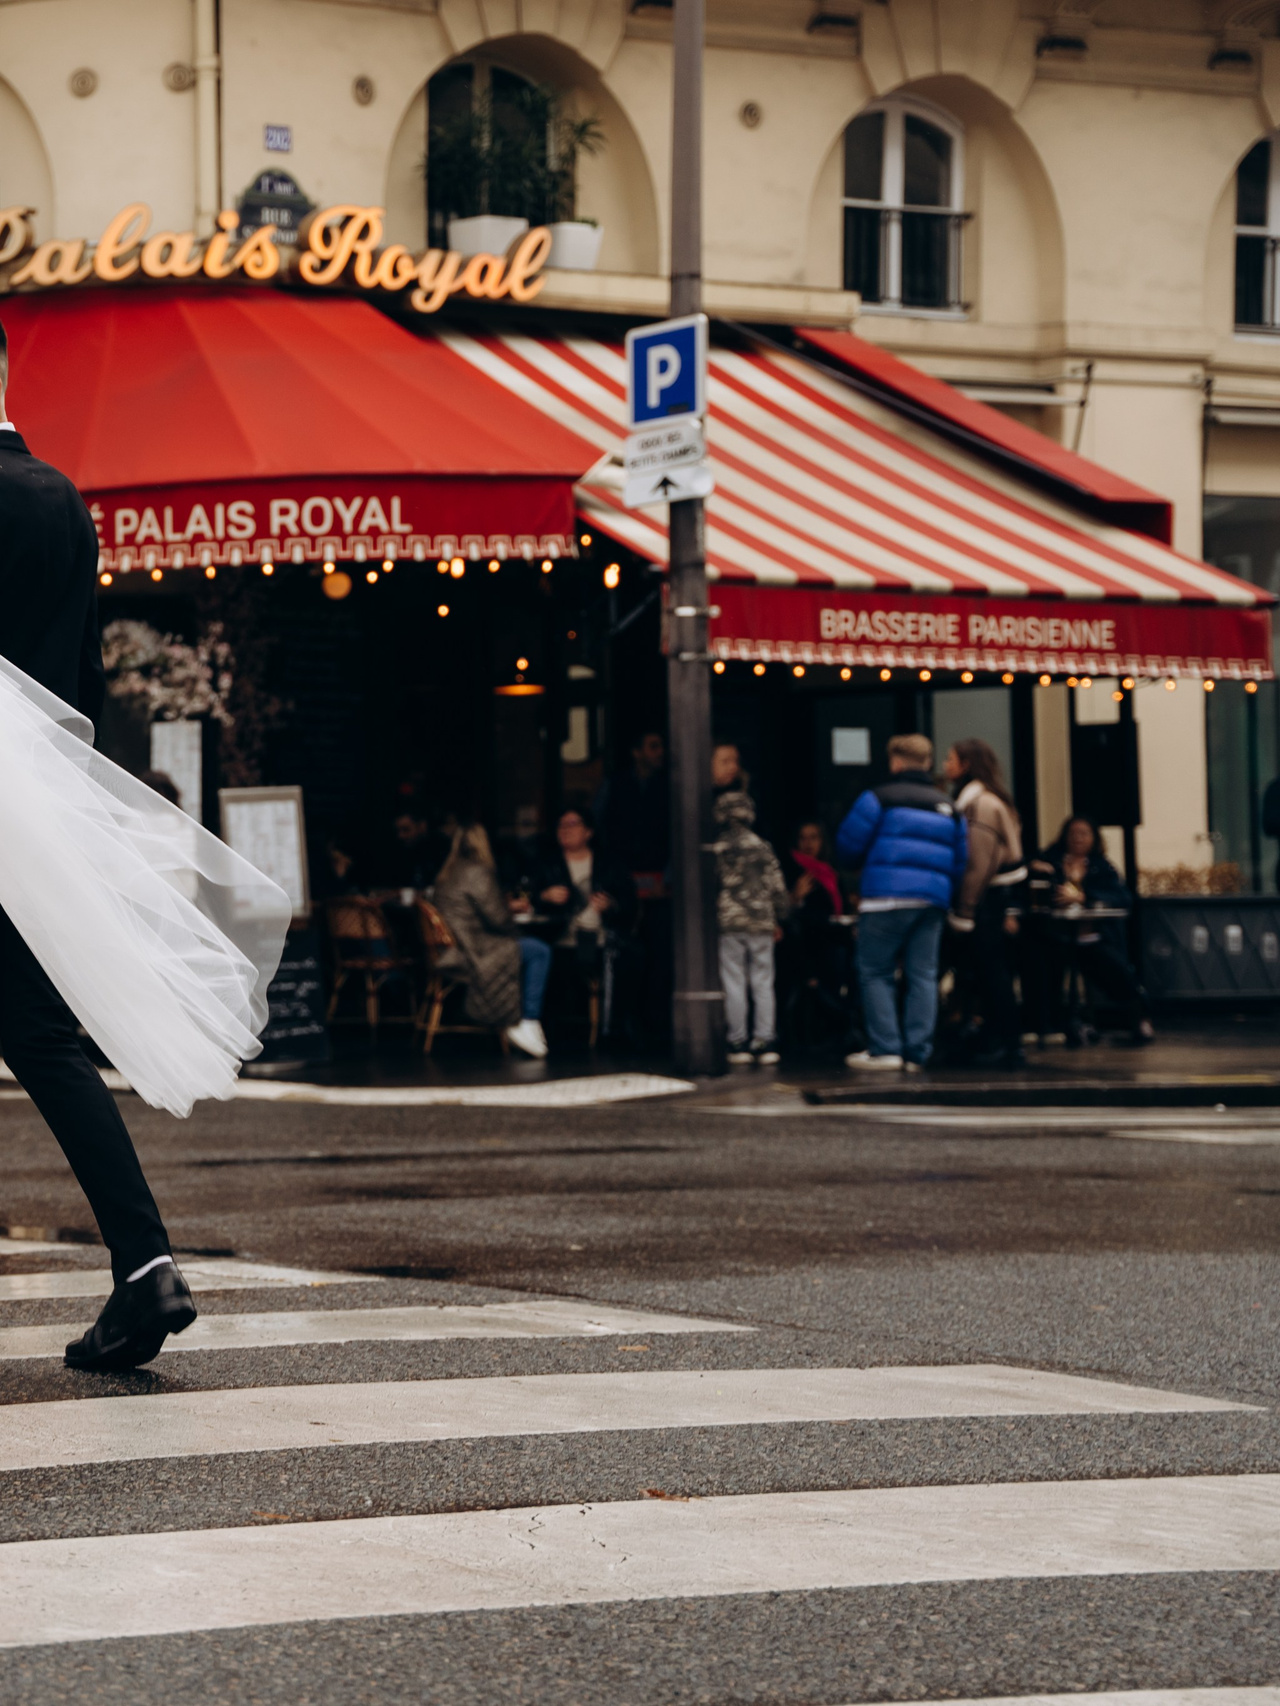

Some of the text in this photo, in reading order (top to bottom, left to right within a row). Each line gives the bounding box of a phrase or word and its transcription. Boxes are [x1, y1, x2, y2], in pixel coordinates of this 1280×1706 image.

[299, 204, 552, 313] Royal
[646, 343, 682, 409] P
[115, 501, 257, 545] PALAIS
[269, 495, 413, 538] ROYAL
[820, 608, 1116, 650] BRASSERIE PARISIENNE
